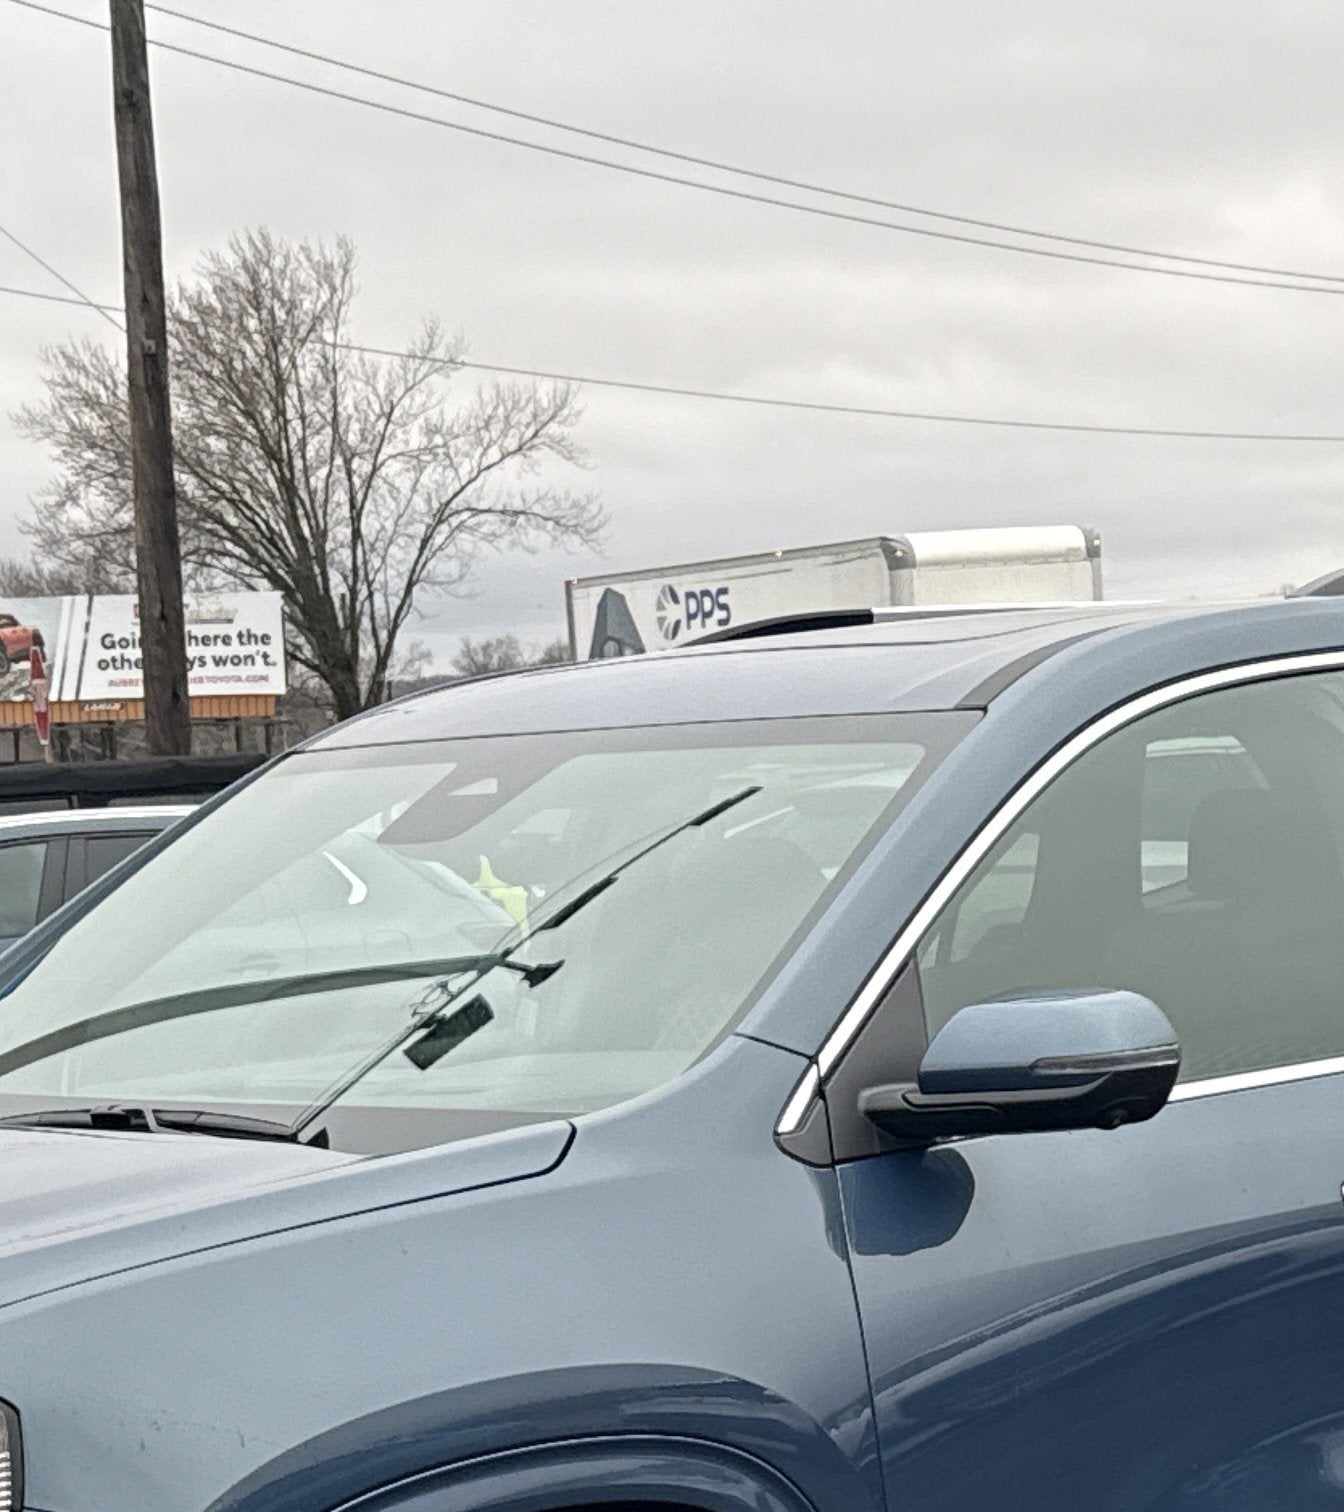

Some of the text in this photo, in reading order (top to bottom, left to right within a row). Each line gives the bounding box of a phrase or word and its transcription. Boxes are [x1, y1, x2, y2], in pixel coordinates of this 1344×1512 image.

[684, 586, 731, 630] PPS
[100, 628, 272, 650] Goi here the
[97, 653, 144, 671] othe
